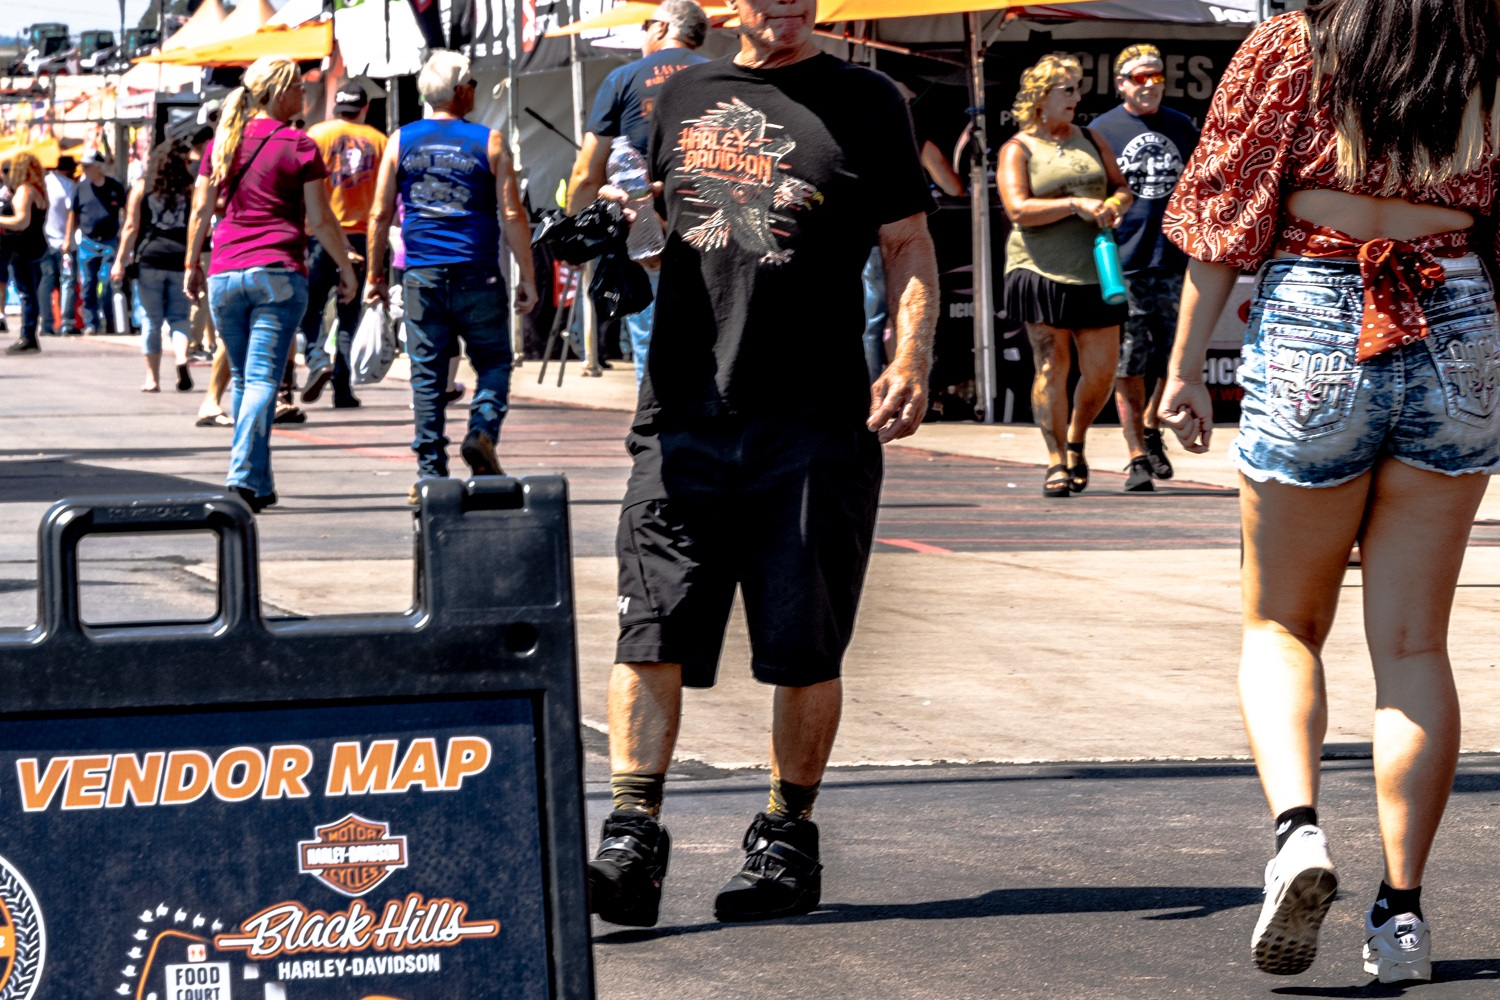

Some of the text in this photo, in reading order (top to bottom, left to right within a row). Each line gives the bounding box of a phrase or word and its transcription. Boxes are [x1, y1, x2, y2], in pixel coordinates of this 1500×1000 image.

[17, 736, 492, 812] VENDOR MAP
[328, 824, 378, 841] MOTOR
[327, 866, 380, 887] CYCLES
[235, 896, 482, 955] Black Hills
[175, 965, 221, 986] FOOD
[277, 953, 441, 980] HARLEY-DAVIDSON
